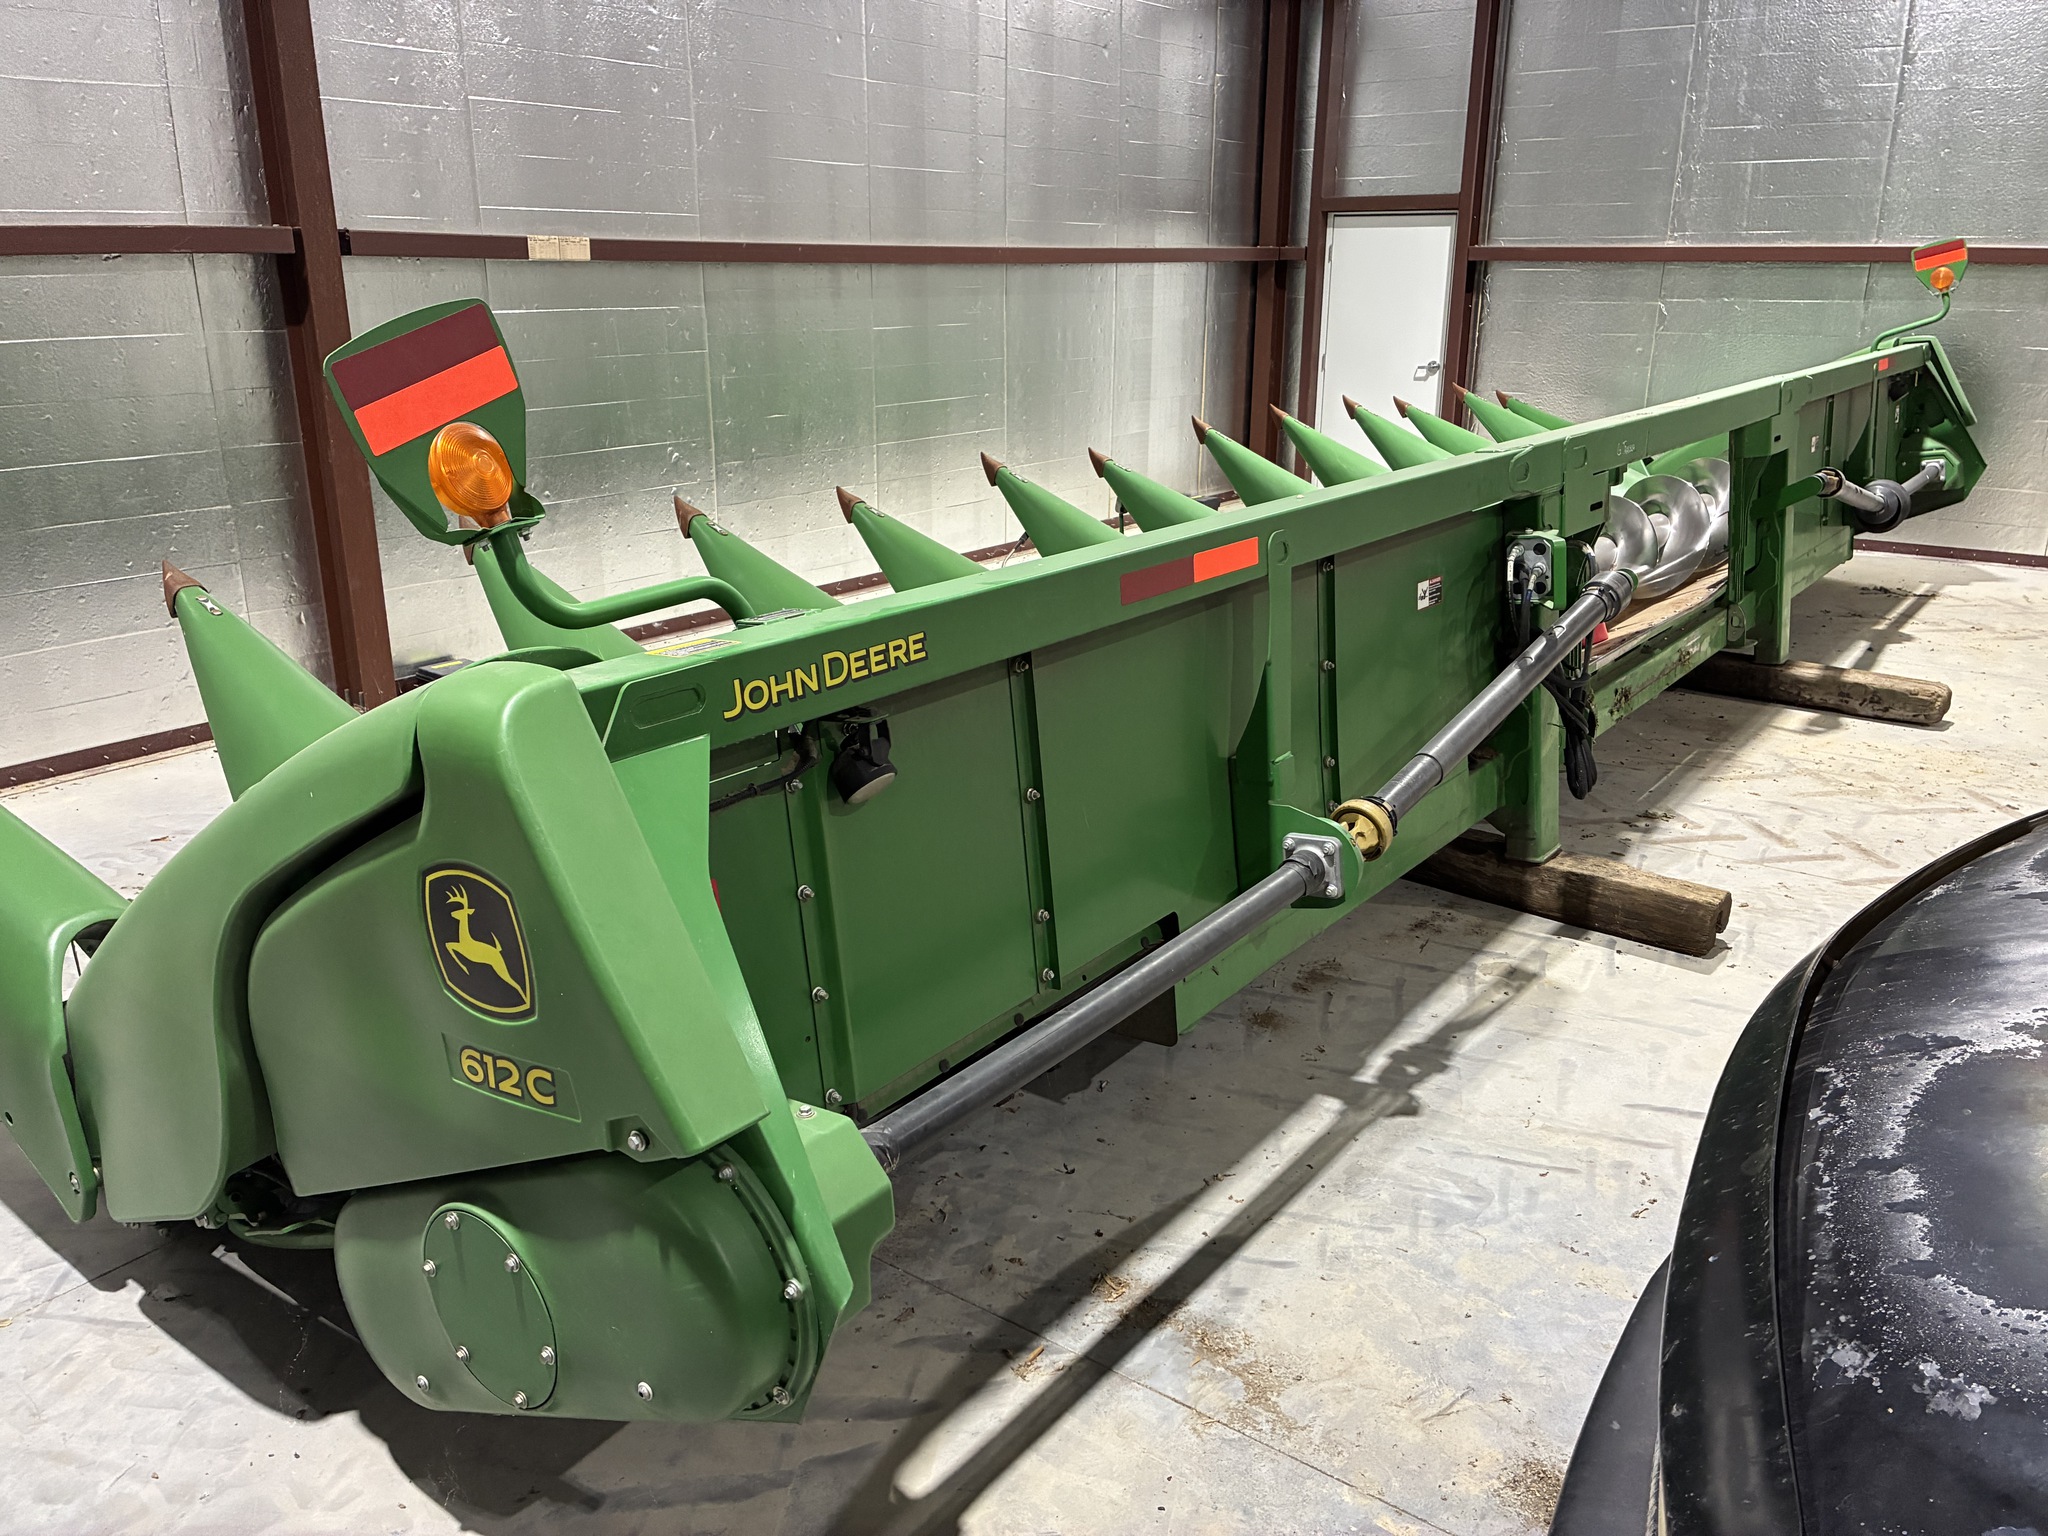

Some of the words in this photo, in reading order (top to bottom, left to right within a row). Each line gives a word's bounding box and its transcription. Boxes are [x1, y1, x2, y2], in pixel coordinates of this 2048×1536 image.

[723, 663, 821, 721] JOHN
[822, 631, 928, 689] DEERE
[460, 1046, 557, 1107] 612C
